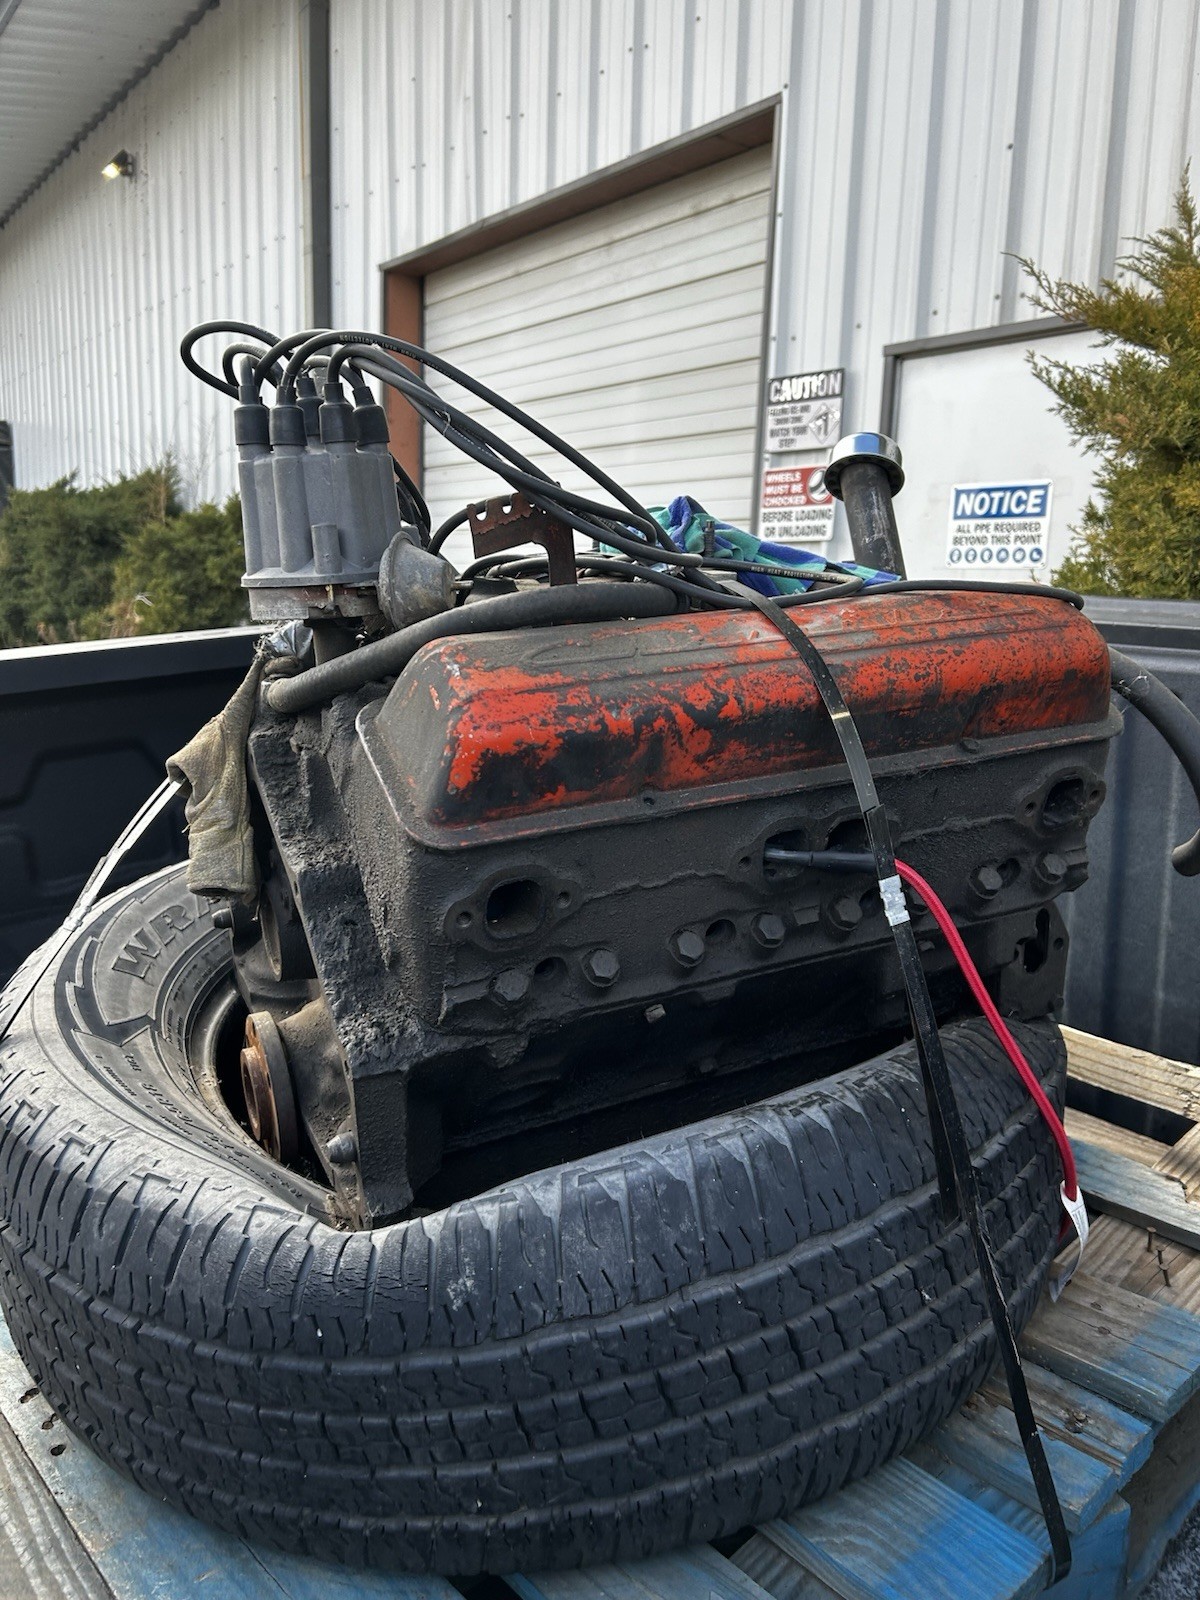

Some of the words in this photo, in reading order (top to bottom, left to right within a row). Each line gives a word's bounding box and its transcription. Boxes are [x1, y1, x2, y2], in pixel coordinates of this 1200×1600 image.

[770, 372, 842, 402] CAUTION
[766, 471, 801, 483] WHEELS
[765, 484, 790, 495] MUST
[790, 483, 804, 494] BE
[764, 494, 807, 507] CHOCKED
[956, 489, 1045, 516] NOTICE
[762, 510, 793, 523] BEFORE
[795, 508, 833, 522] LOADING
[765, 527, 775, 538] OR
[778, 524, 827, 538] UNLOADING
[956, 524, 971, 534] ALL
[974, 522, 991, 533] PPE
[993, 521, 1042, 534] REQUIRED
[952, 534, 988, 546] BEYOND
[991, 534, 1011, 546] THIS
[1013, 533, 1042, 545] POINT
[767, 567, 781, 575] HEAT
[783, 569, 814, 578] PROTECTION
